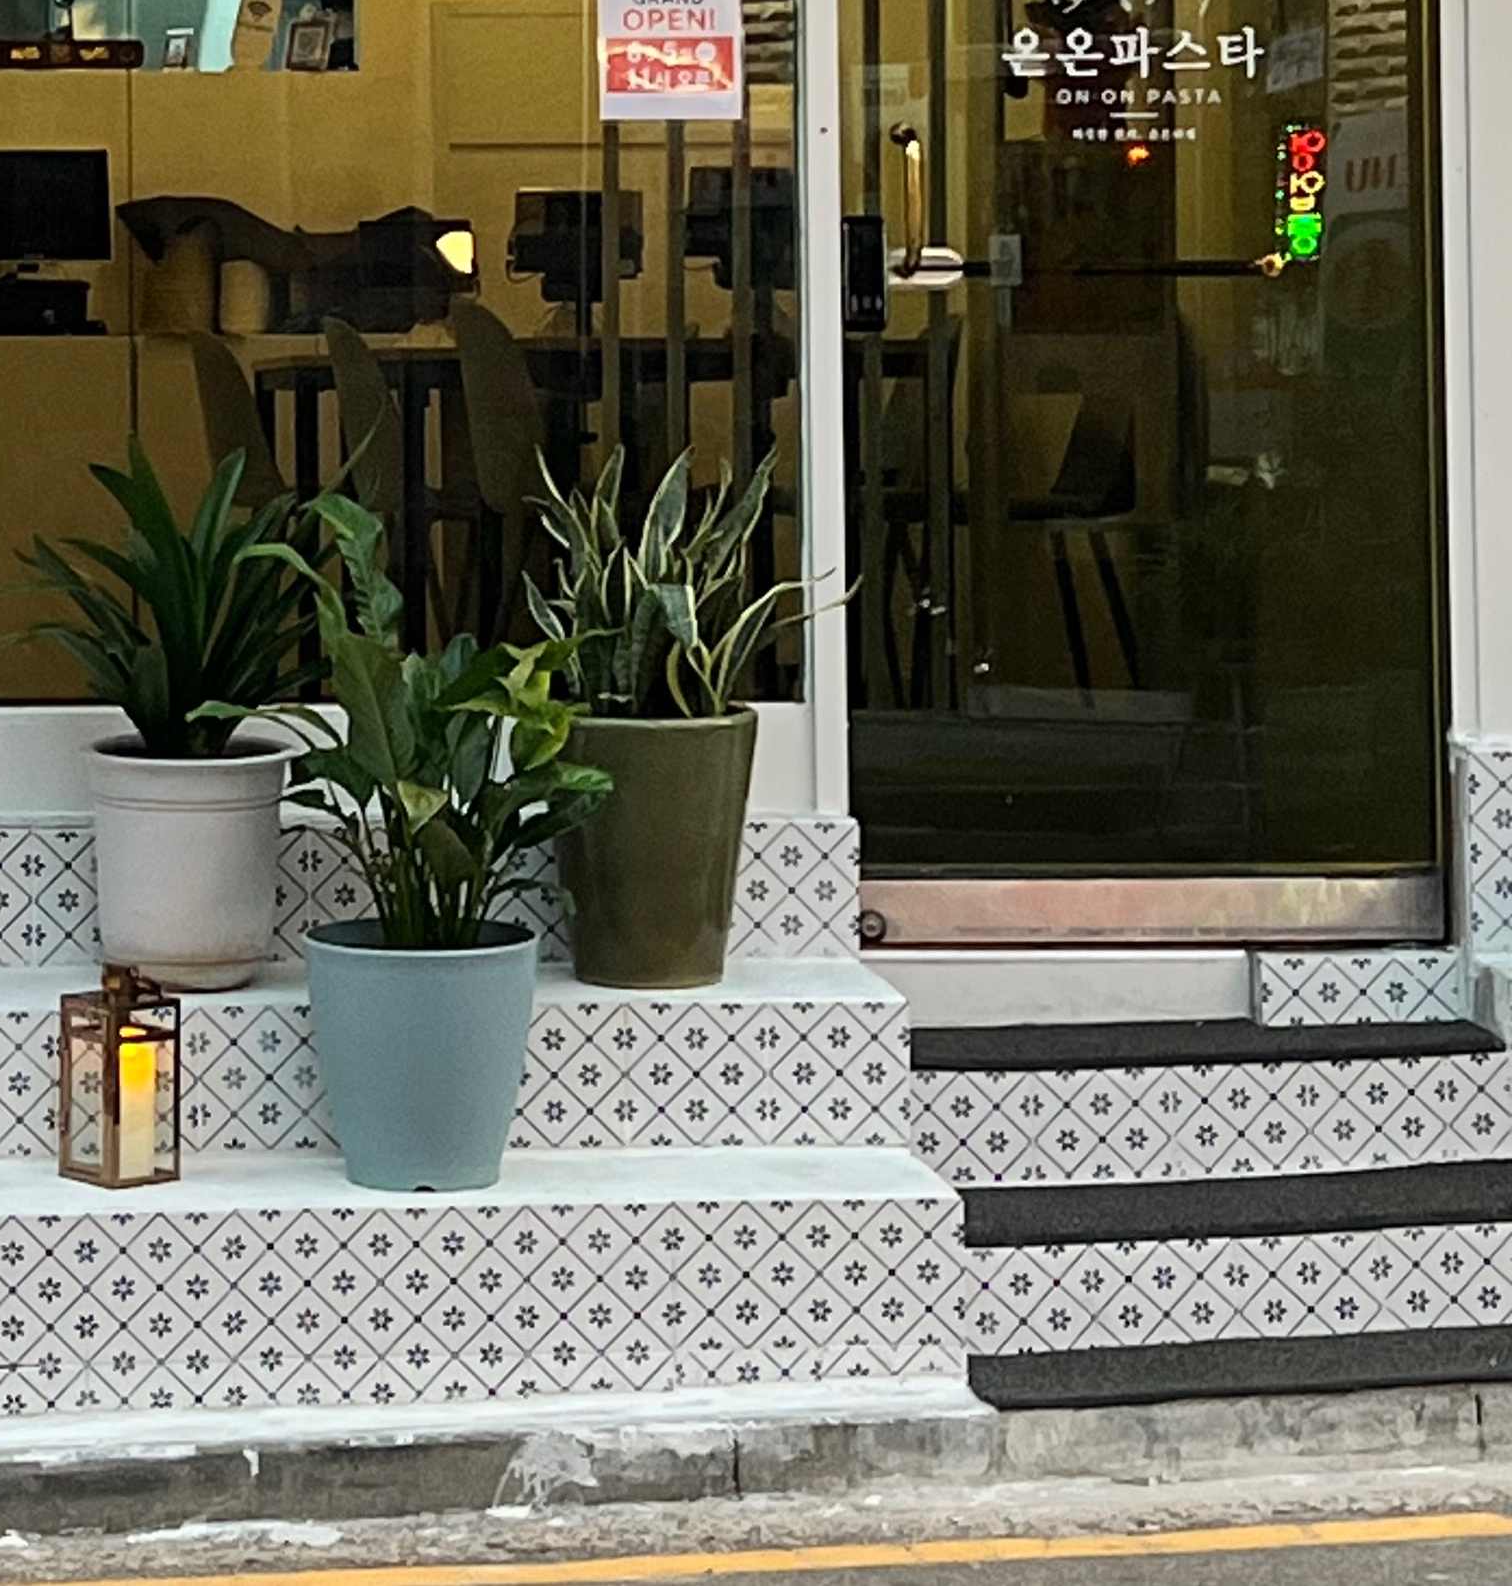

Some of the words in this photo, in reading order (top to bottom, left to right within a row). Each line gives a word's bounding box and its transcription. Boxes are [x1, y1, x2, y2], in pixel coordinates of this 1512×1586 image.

[1001, 25, 1265, 79] 온온파스타
[1055, 88, 1090, 106] ON
[1100, 88, 1136, 106] ON
[1145, 88, 1222, 106] PASTA
